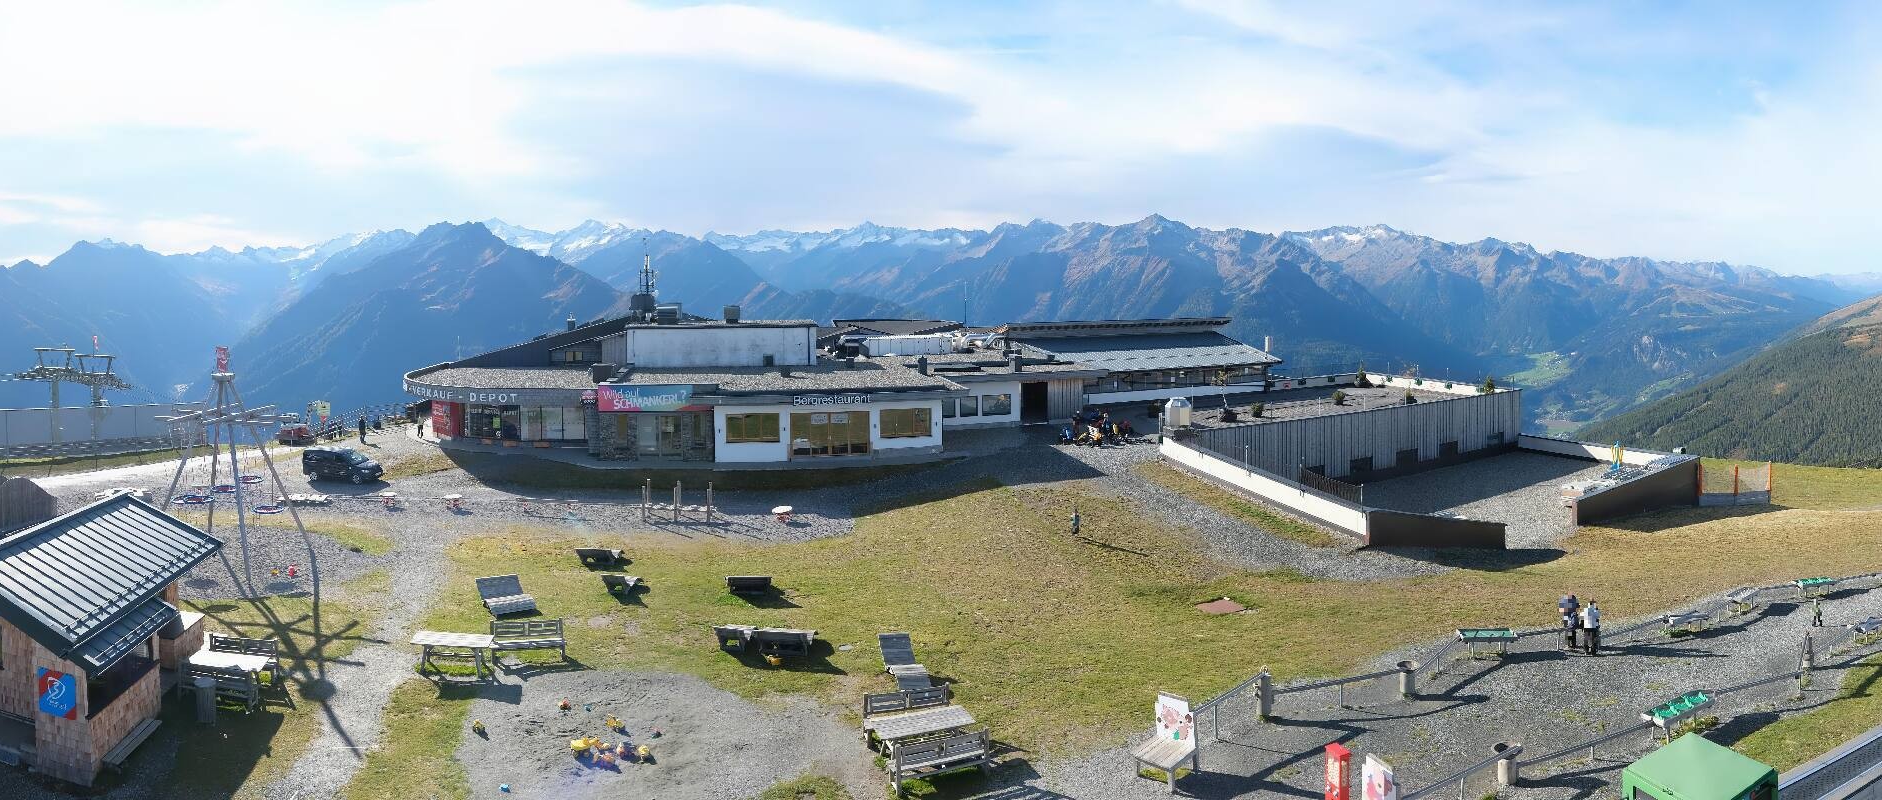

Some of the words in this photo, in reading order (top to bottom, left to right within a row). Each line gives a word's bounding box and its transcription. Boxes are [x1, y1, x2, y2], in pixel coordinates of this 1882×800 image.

[412, 386, 453, 399] VERKAUF
[470, 393, 517, 402] DEPOT
[603, 388, 624, 401] Wild
[625, 387, 640, 399] auf
[794, 394, 870, 406] Bergrestaurant
